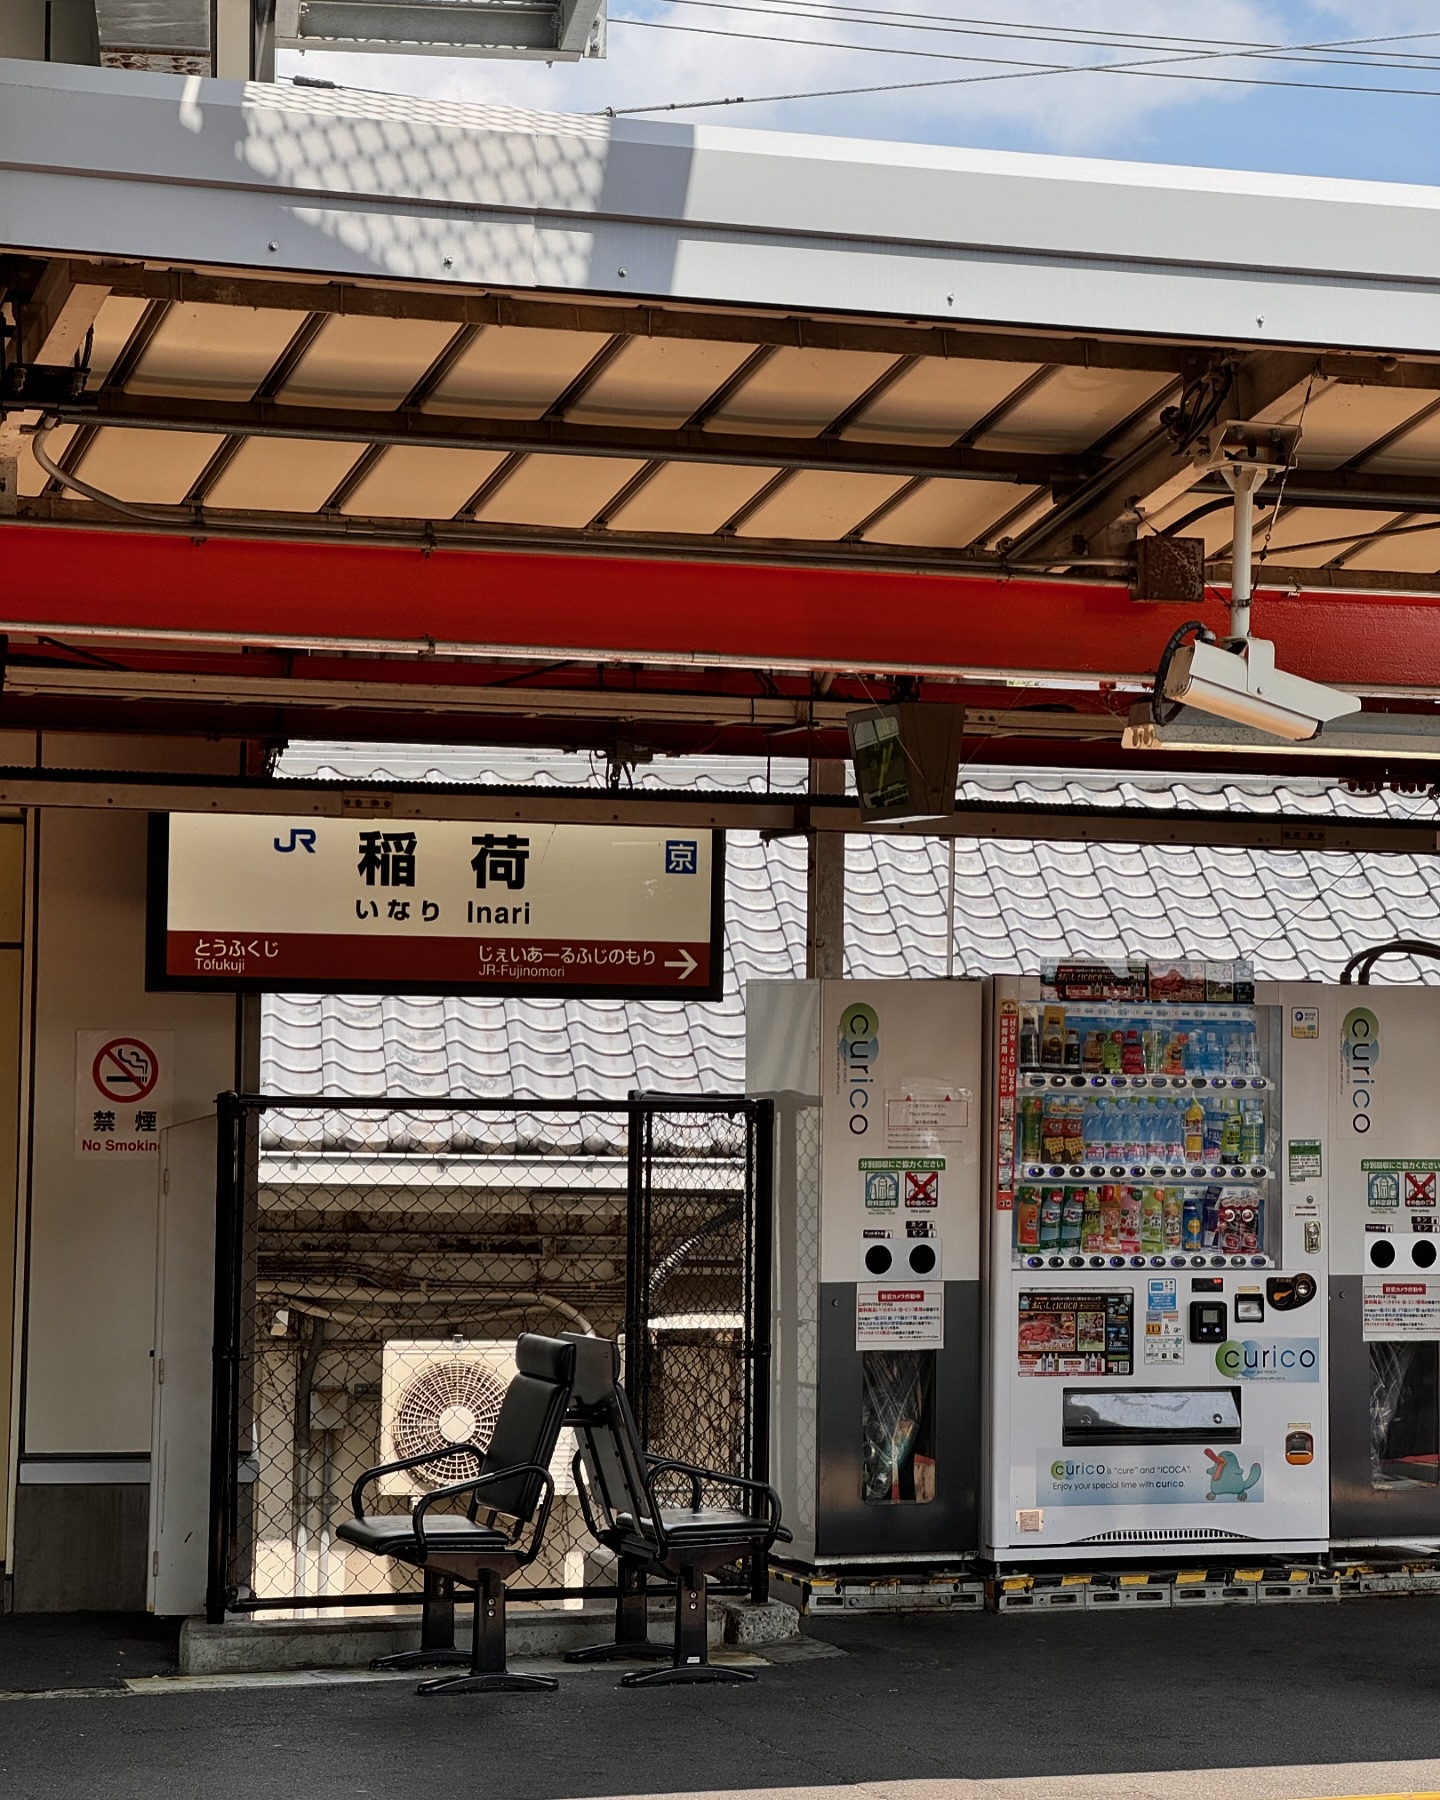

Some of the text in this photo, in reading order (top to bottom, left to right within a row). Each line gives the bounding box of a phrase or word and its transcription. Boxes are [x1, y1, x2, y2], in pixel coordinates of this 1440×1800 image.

[273, 828, 317, 854] JR
[357, 830, 530, 890] 稲荷
[668, 843, 694, 871] 京
[355, 899, 530, 924] いなり Inari
[194, 939, 279, 958] とうふくじ
[478, 945, 656, 966] じぇいあーるふじのもり
[194, 957, 245, 974] Tōfukuji
[478, 964, 565, 979] JR-Fujinomori
[1009, 1047, 1015, 1063] to
[849, 1013, 874, 1135] curico
[1351, 1018, 1375, 1134] curico
[93, 1109, 157, 1132] 禁煙
[82, 1139, 160, 1152] No Smokin
[1224, 1345, 1316, 1368] curico
[1055, 1462, 1106, 1475] curico
[1140, 1466, 1155, 1474] and
[1052, 1482, 1073, 1492] Enjoy
[1074, 1482, 1091, 1491] your
[1092, 1480, 1119, 1490] special
[1120, 1480, 1138, 1489] time
[1138, 1480, 1155, 1488] with
